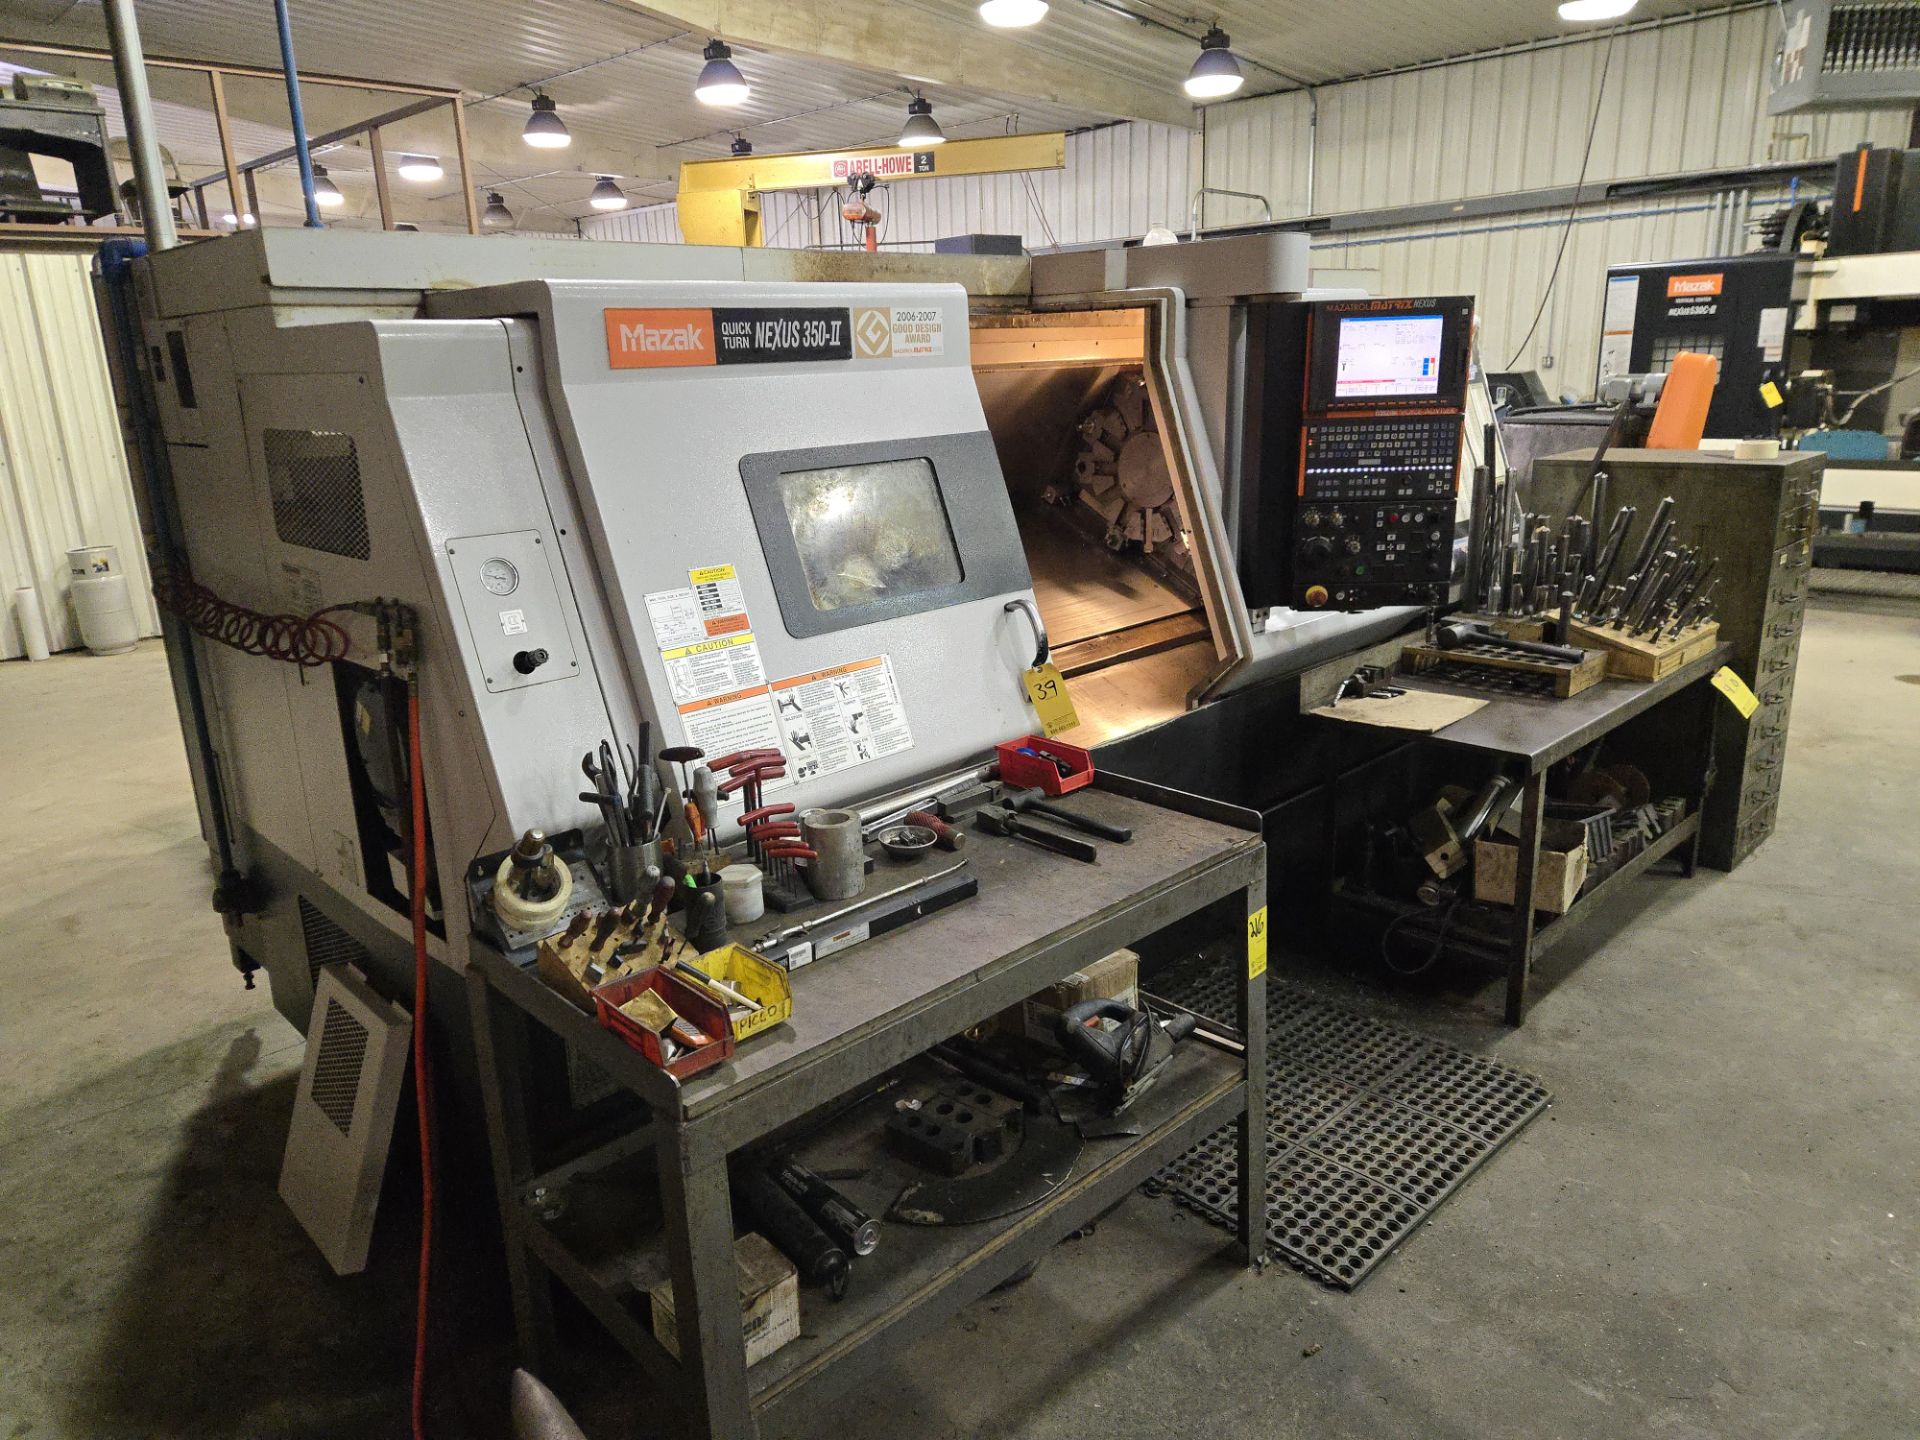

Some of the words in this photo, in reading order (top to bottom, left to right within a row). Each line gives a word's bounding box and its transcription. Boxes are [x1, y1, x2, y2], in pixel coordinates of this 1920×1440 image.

[849, 155, 912, 175] ABELL-HOWE
[920, 155, 927, 165] 2
[1673, 279, 1716, 293] Mazak
[1412, 298, 1437, 308] NEXUS
[721, 321, 752, 336] QUICK
[754, 318, 801, 351] NEXUS
[892, 323, 914, 334] GOOD
[915, 322, 942, 333] DESIGN
[620, 323, 705, 353] Mazak
[722, 336, 750, 350] TURN
[904, 333, 931, 344] AWARD
[696, 638, 734, 653] CAUTION
[821, 666, 847, 678] WARNING
[1033, 679, 1058, 700] 39
[714, 692, 742, 704] WARNING
